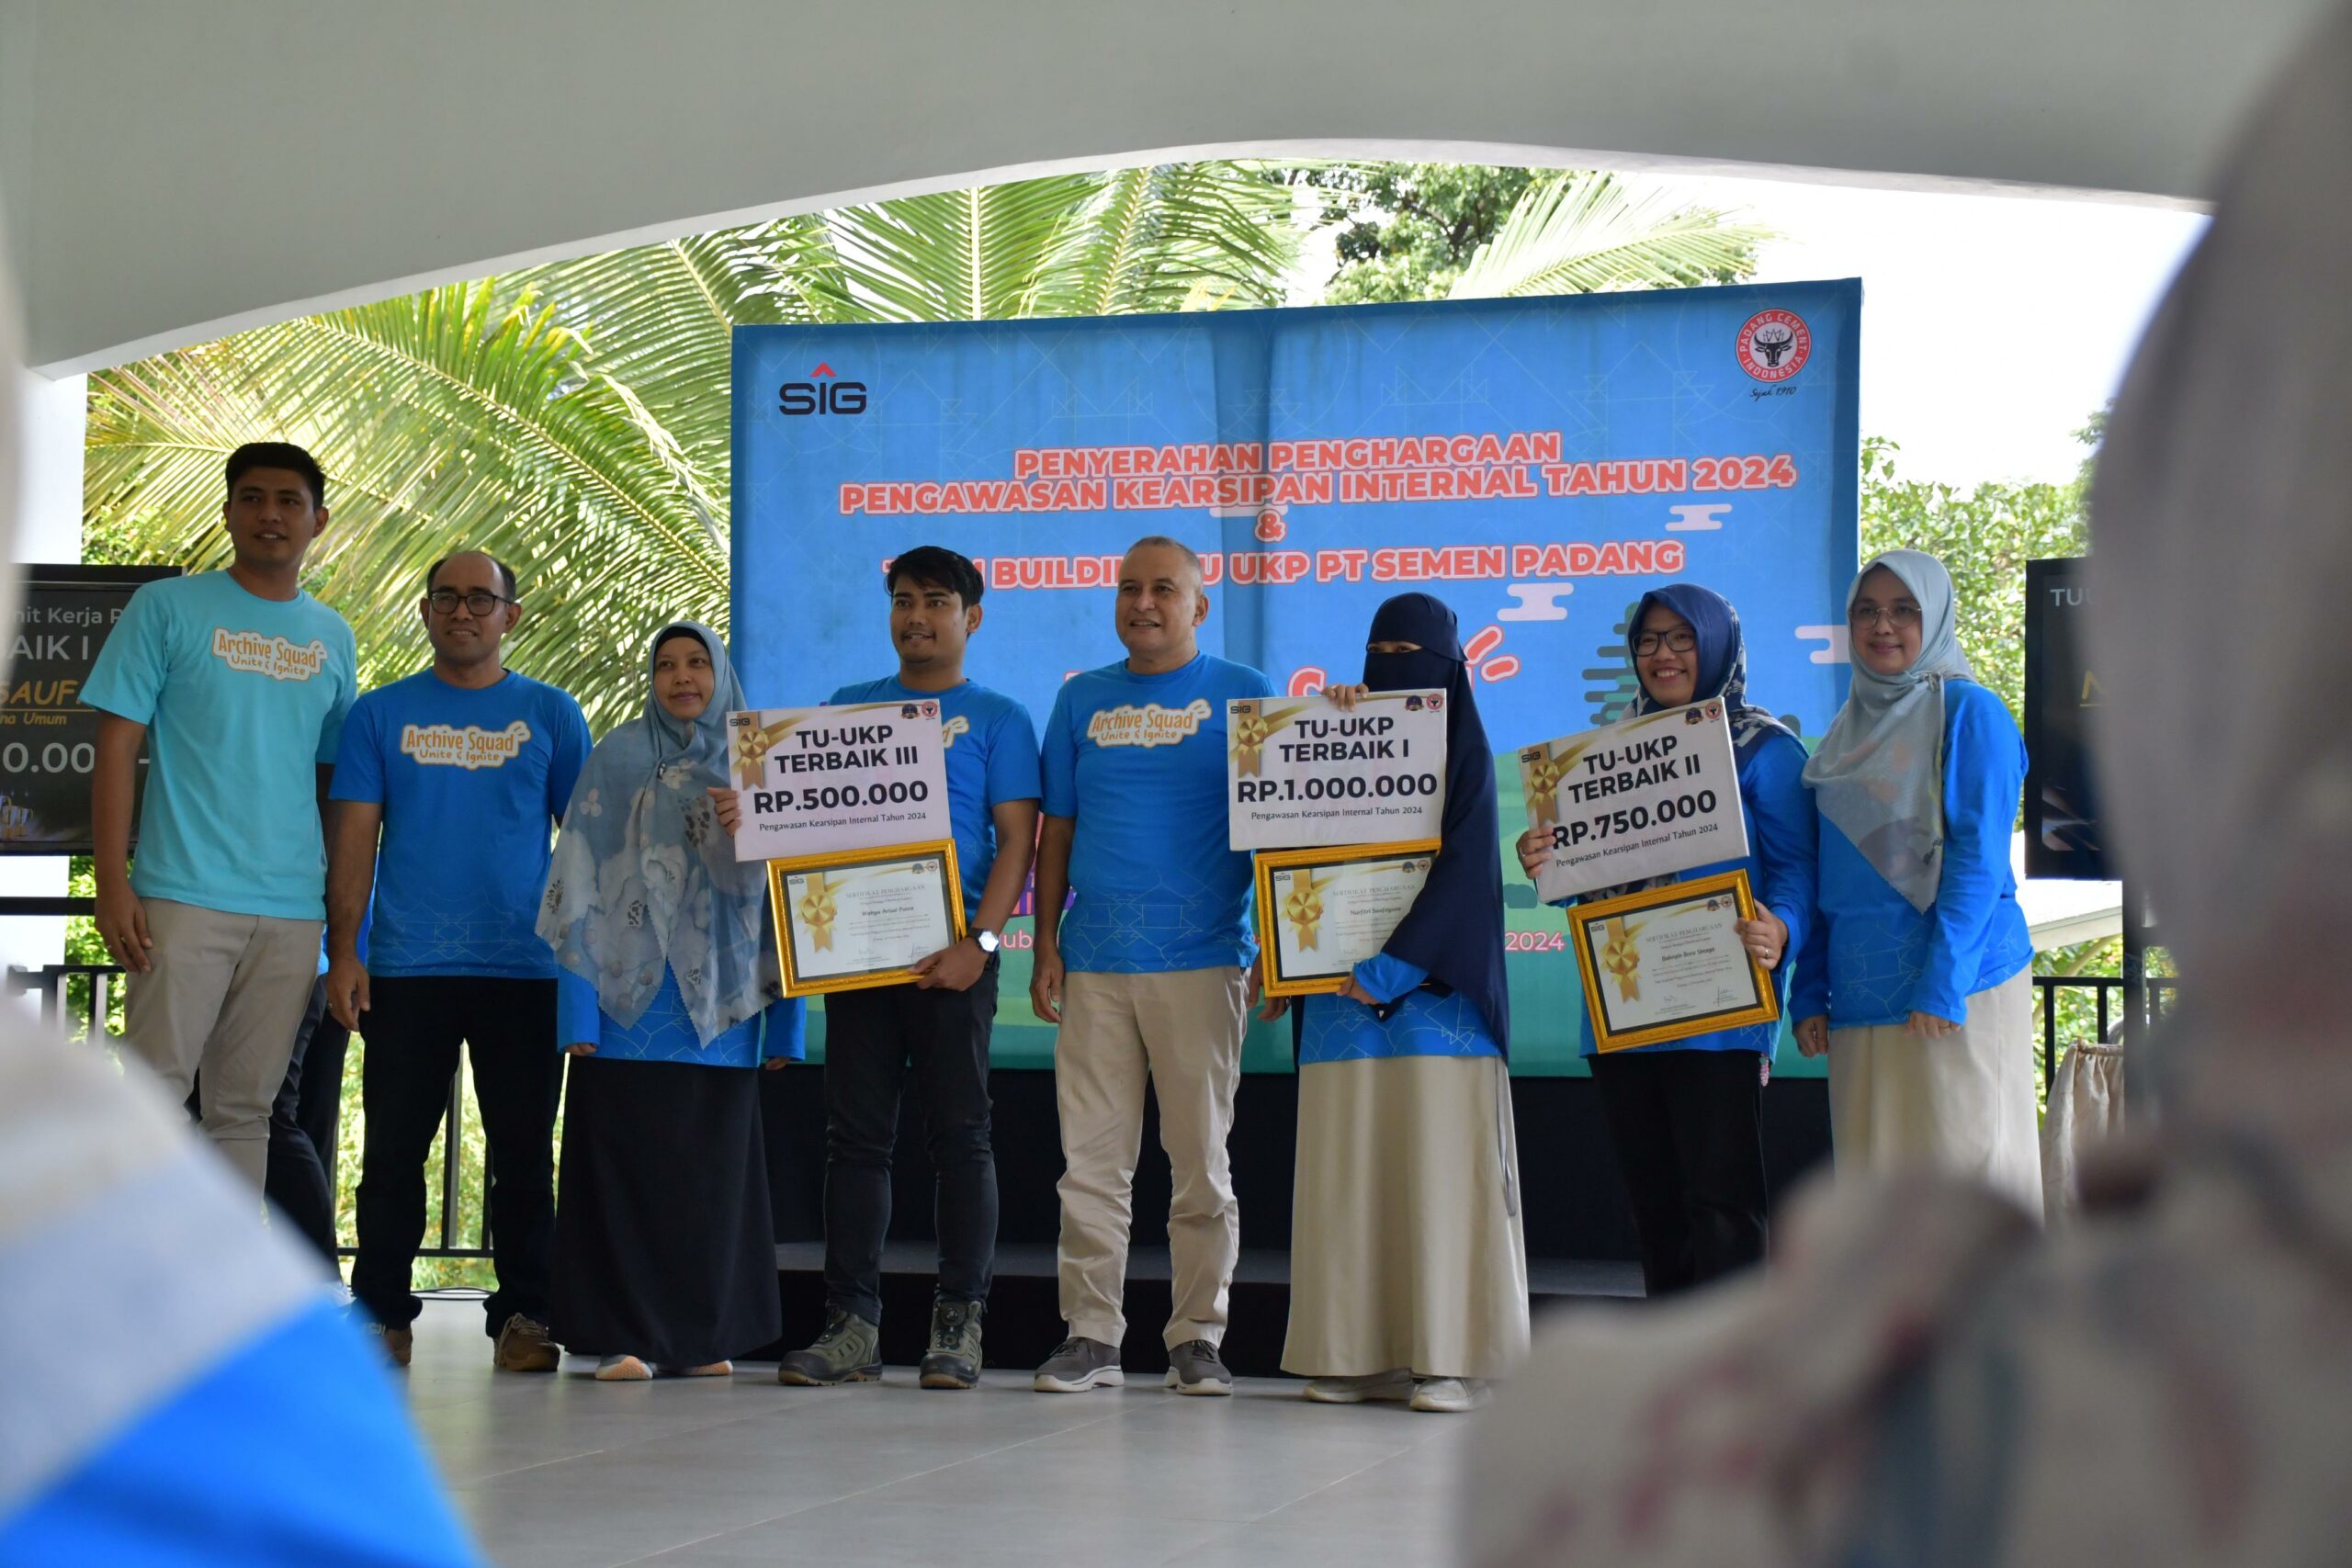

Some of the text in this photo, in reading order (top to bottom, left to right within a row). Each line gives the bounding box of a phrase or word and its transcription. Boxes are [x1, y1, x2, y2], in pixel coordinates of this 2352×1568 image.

[1740, 313, 1807, 352] PADANG CEMENT
[1743, 355, 1803, 378] INDONESIA
[779, 381, 866, 415] SIG
[1749, 385, 1796, 401] Sejak 1910
[1015, 432, 1560, 479] PENYERAHAN PENGHARGAAN
[840, 455, 1797, 514] PENGAWASAN KEARSIPAN INTERNAL TAHUN 2024
[1255, 509, 1285, 542] &
[992, 555, 1119, 588] BUILDI
[1199, 552, 1223, 585] U
[1229, 551, 1310, 584] UKP
[1316, 549, 1368, 582] PT
[1372, 546, 1505, 581] SEMEN
[1512, 540, 1685, 578] PADANG
[48, 607, 103, 627] Kerja
[8, 635, 70, 660] AIK
[219, 634, 316, 668] Archive Squad
[232, 655, 263, 667] Unite
[274, 662, 305, 675] Ignite
[24, 712, 67, 725] Umum
[1092, 709, 1193, 732] Archive Squad
[1230, 705, 1251, 714] SIG
[729, 717, 751, 727] SIG
[1295, 716, 1394, 739] TU-UKP
[407, 729, 514, 753] Archive Squad
[796, 725, 893, 750] TU-UKP
[1102, 730, 1130, 740] Unite
[1144, 729, 1177, 741] Ignite
[420, 750, 452, 758] Unite
[466, 751, 500, 763] Ignite
[775, 746, 918, 773] TERBAIK III
[1279, 739, 1409, 762] TERBAIK I
[1521, 751, 1541, 762] SIG
[1583, 735, 1678, 775] TU-UKP
[1238, 773, 1437, 803] RP.1.000.000
[1568, 754, 1701, 804] TERBAIK II
[754, 781, 928, 814] RP.500.000
[759, 812, 926, 831] Pengawasan Kearsipan Internal Tahun 2024
[1251, 811, 1299, 820] Pengawasan
[1302, 809, 1340, 819] Kearsipan
[1342, 808, 1373, 817] Internal
[1553, 790, 1716, 850] RP.750.000
[1556, 823, 1718, 867] Pengawasan Kearsipan Internal Tahun 2024
[1505, 931, 1565, 952] 2024
